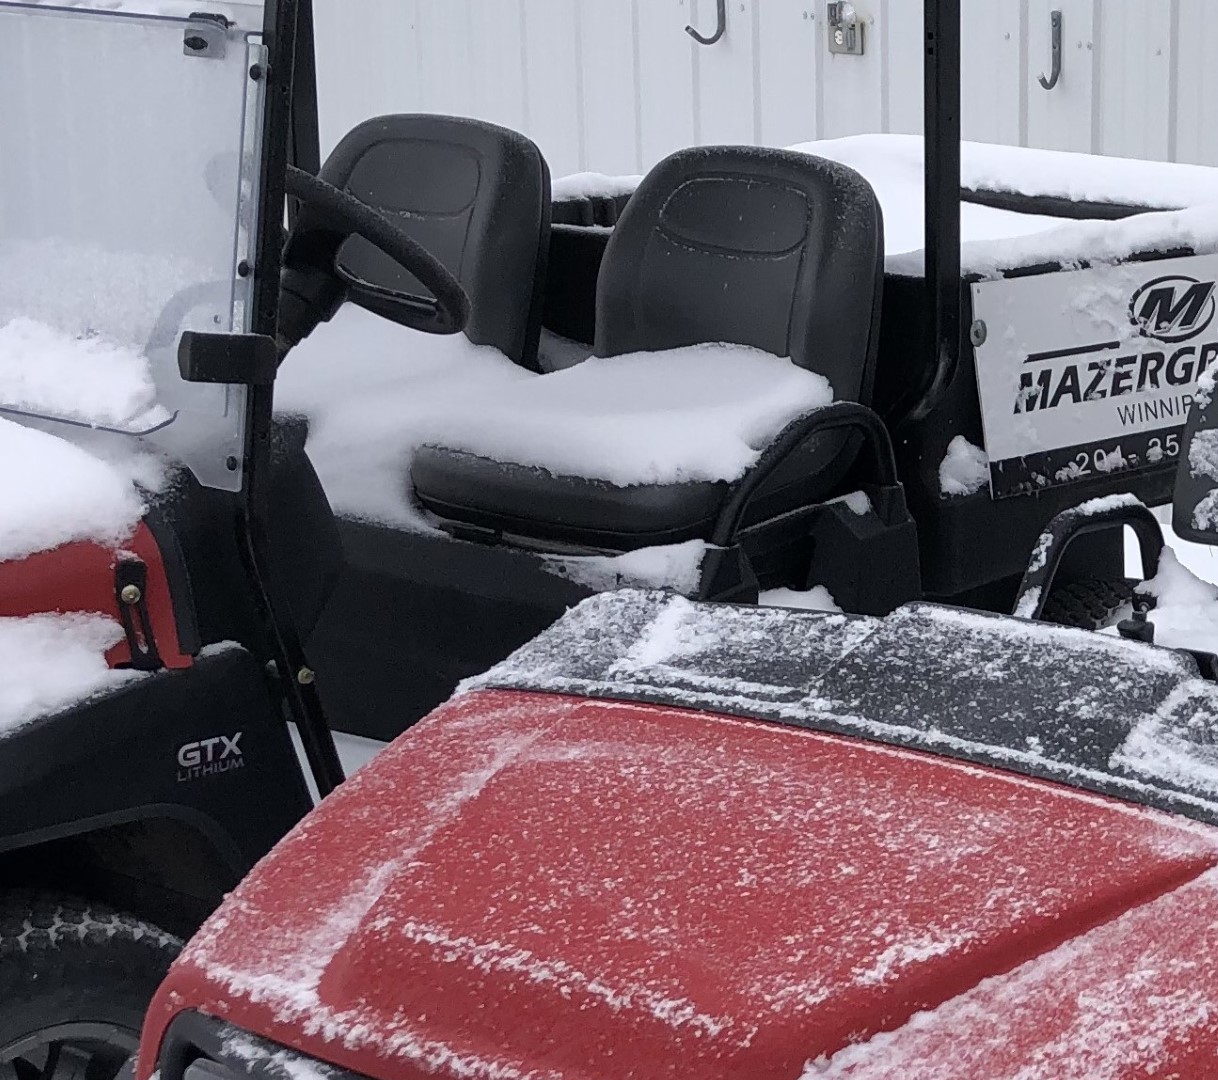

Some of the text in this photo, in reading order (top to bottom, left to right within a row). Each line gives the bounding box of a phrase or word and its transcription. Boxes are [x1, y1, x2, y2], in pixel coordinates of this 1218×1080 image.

[1116, 394, 1195, 427] WINNIP
[177, 731, 243, 768] GTX
[177, 757, 245, 782] LITHIUM
